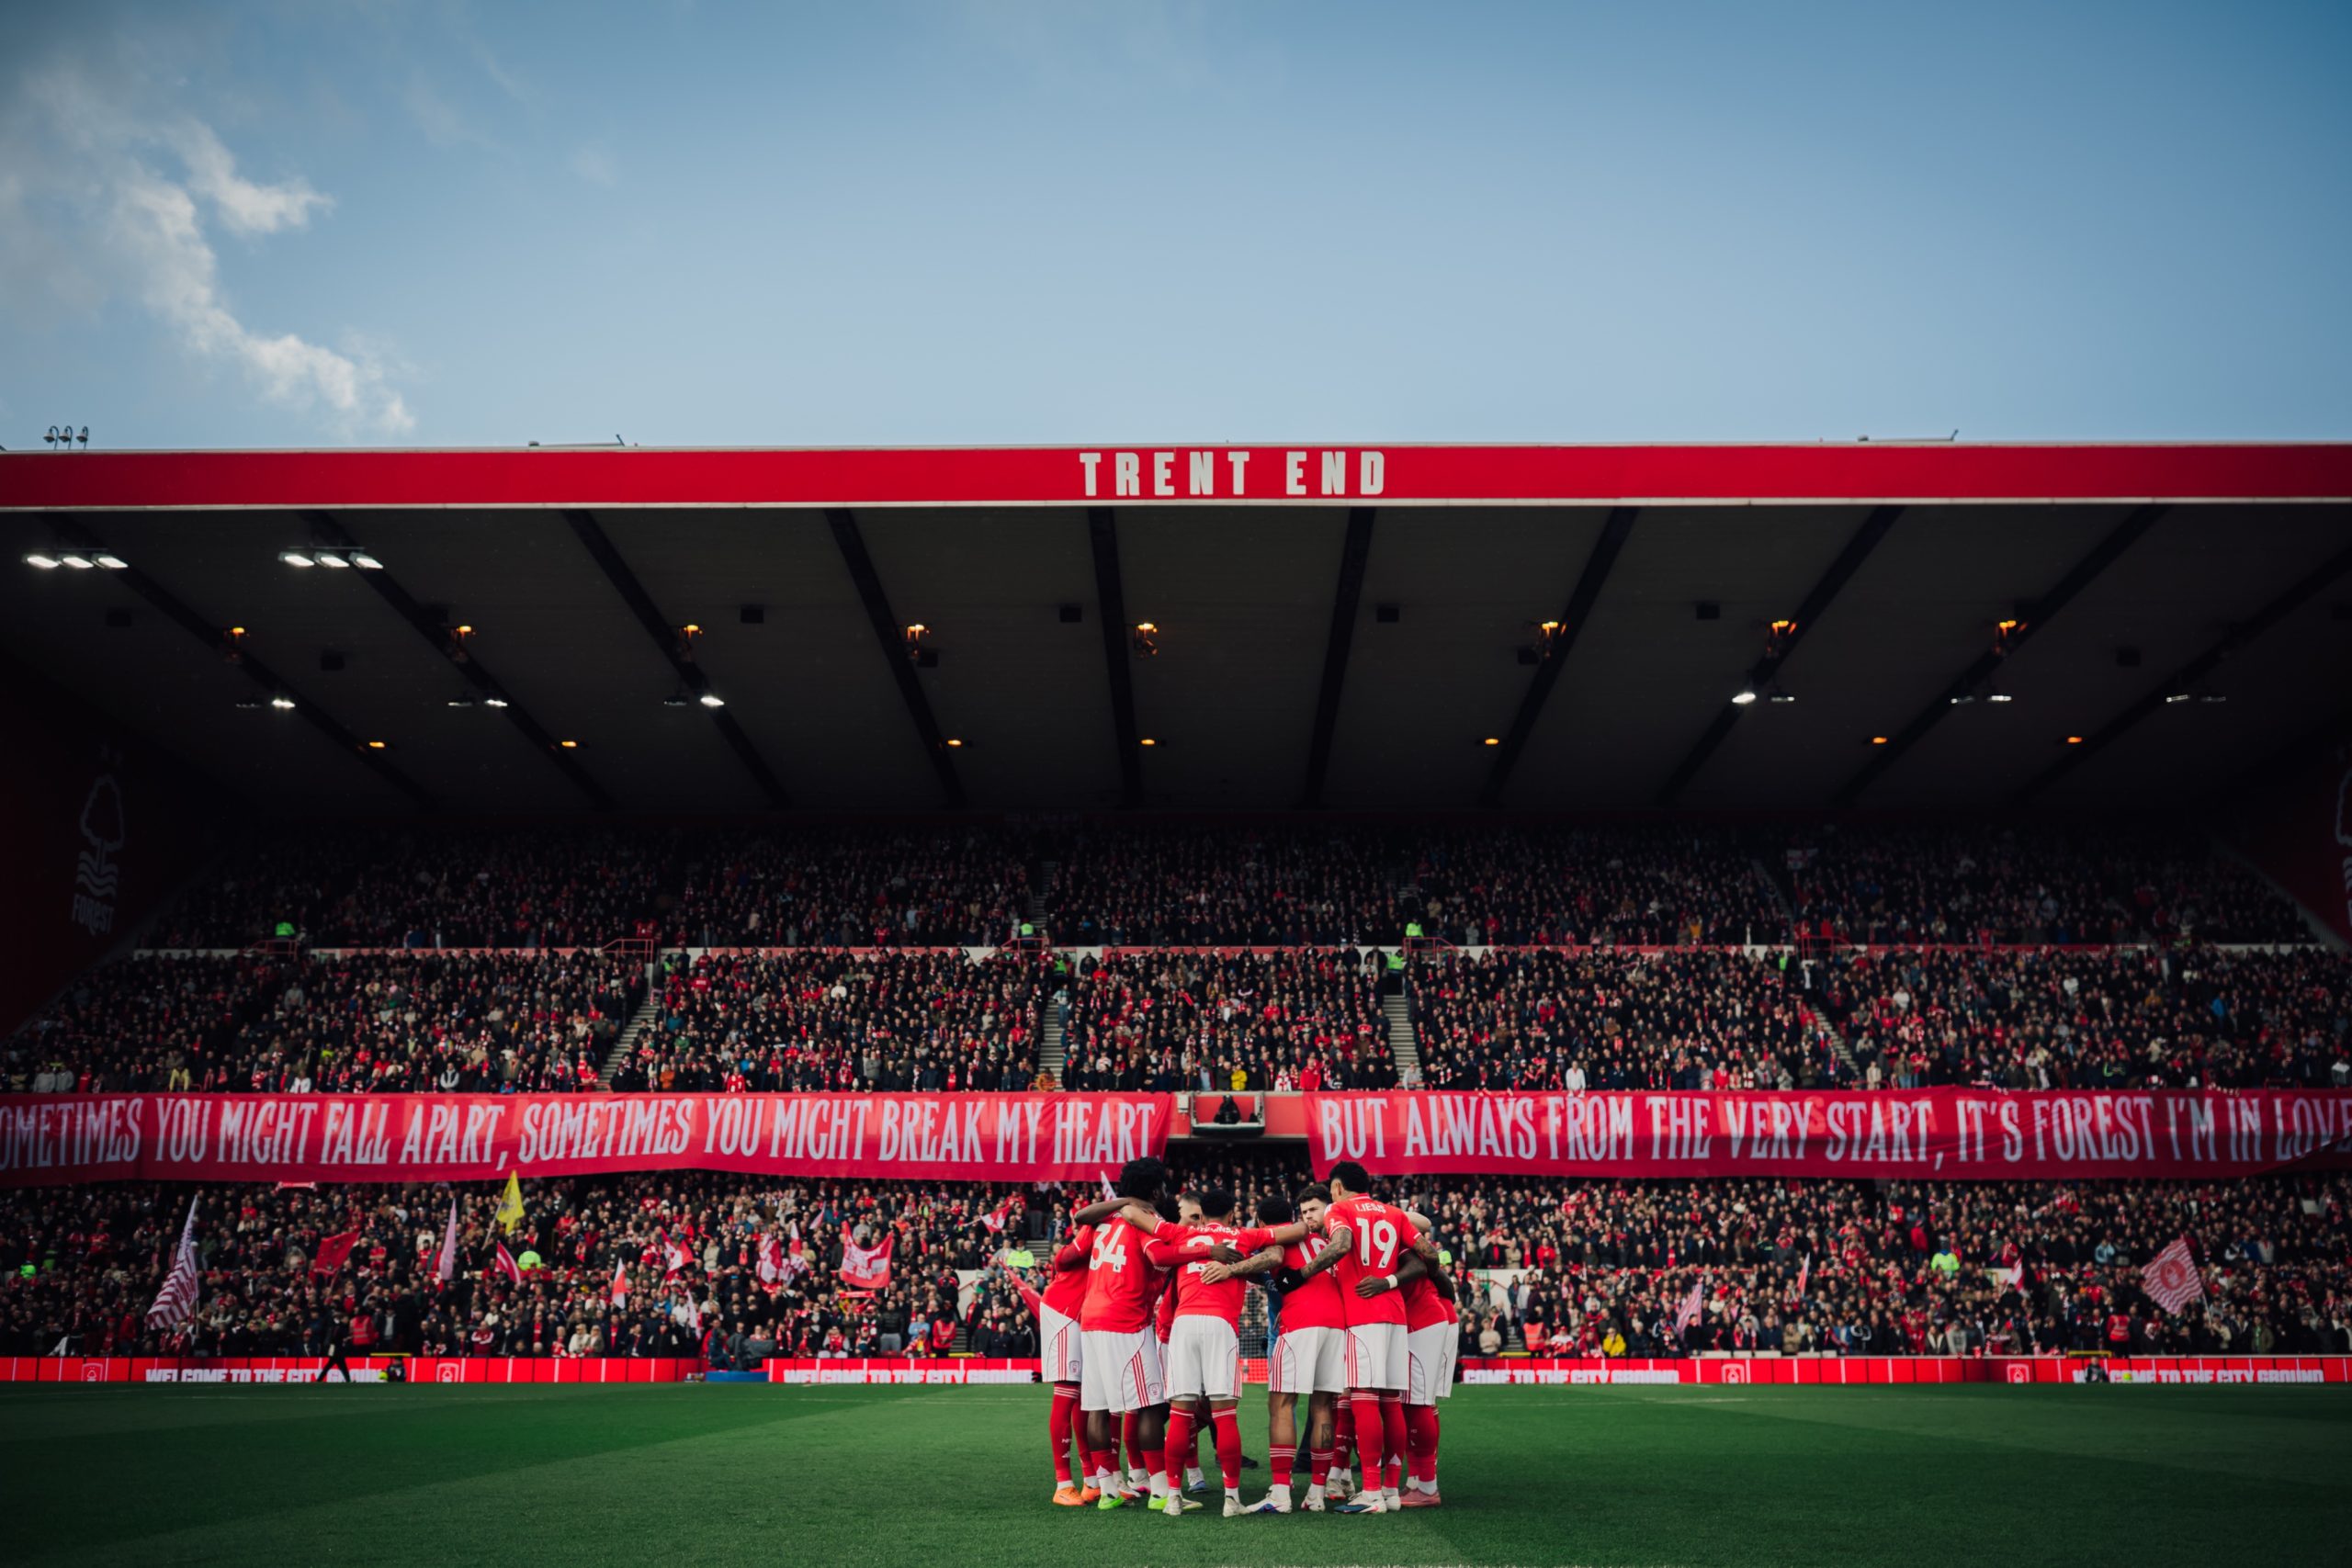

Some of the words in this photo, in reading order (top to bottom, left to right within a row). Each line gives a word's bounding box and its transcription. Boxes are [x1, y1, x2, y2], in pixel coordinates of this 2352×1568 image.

[1079, 451, 1250, 496] TRENT
[1286, 451, 1385, 495] END
[154, 1098, 212, 1163] YOU
[217, 1100, 318, 1165] MIGHT
[319, 1102, 391, 1165] FALL
[398, 1103, 509, 1171] APART,
[517, 1099, 692, 1164] SOMETIMES
[703, 1098, 770, 1157] YOU
[769, 1098, 873, 1160] MIGHT
[877, 1100, 986, 1164] BREAK
[995, 1101, 1046, 1165] MY
[1052, 1101, 1155, 1165] HEART
[1320, 1098, 1387, 1161] BUT
[1404, 1094, 1538, 1160] ALWAYS
[1546, 1095, 1634, 1162] FROM
[1645, 1096, 1712, 1160] THE
[1724, 1100, 1814, 1160] VERY
[1826, 1100, 1944, 1171] START,
[1955, 1098, 2022, 1162] IT'S
[2032, 1096, 2156, 1162] FOREST
[2165, 1097, 2218, 1161] I'M
[2226, 1097, 2263, 1162] IN
[1089, 1223, 1127, 1273] 34
[1355, 1217, 1397, 1269] 19
[145, 1369, 228, 1382] WELCOME
[230, 1369, 251, 1382] TO
[254, 1369, 286, 1382] THE
[287, 1369, 321, 1382] CITY
[784, 1370, 867, 1383] WELCOME
[868, 1370, 891, 1383] TO
[892, 1370, 925, 1383] THE
[926, 1370, 966, 1383] CITY
[1512, 1369, 1535, 1383] TO
[1536, 1369, 1569, 1383] THE
[1570, 1370, 1610, 1383] CITY
[2158, 1369, 2181, 1382] TO
[2182, 1369, 2213, 1382] THE
[2216, 1370, 2255, 1382] CITY
[2256, 1370, 2324, 1382] GROUND
